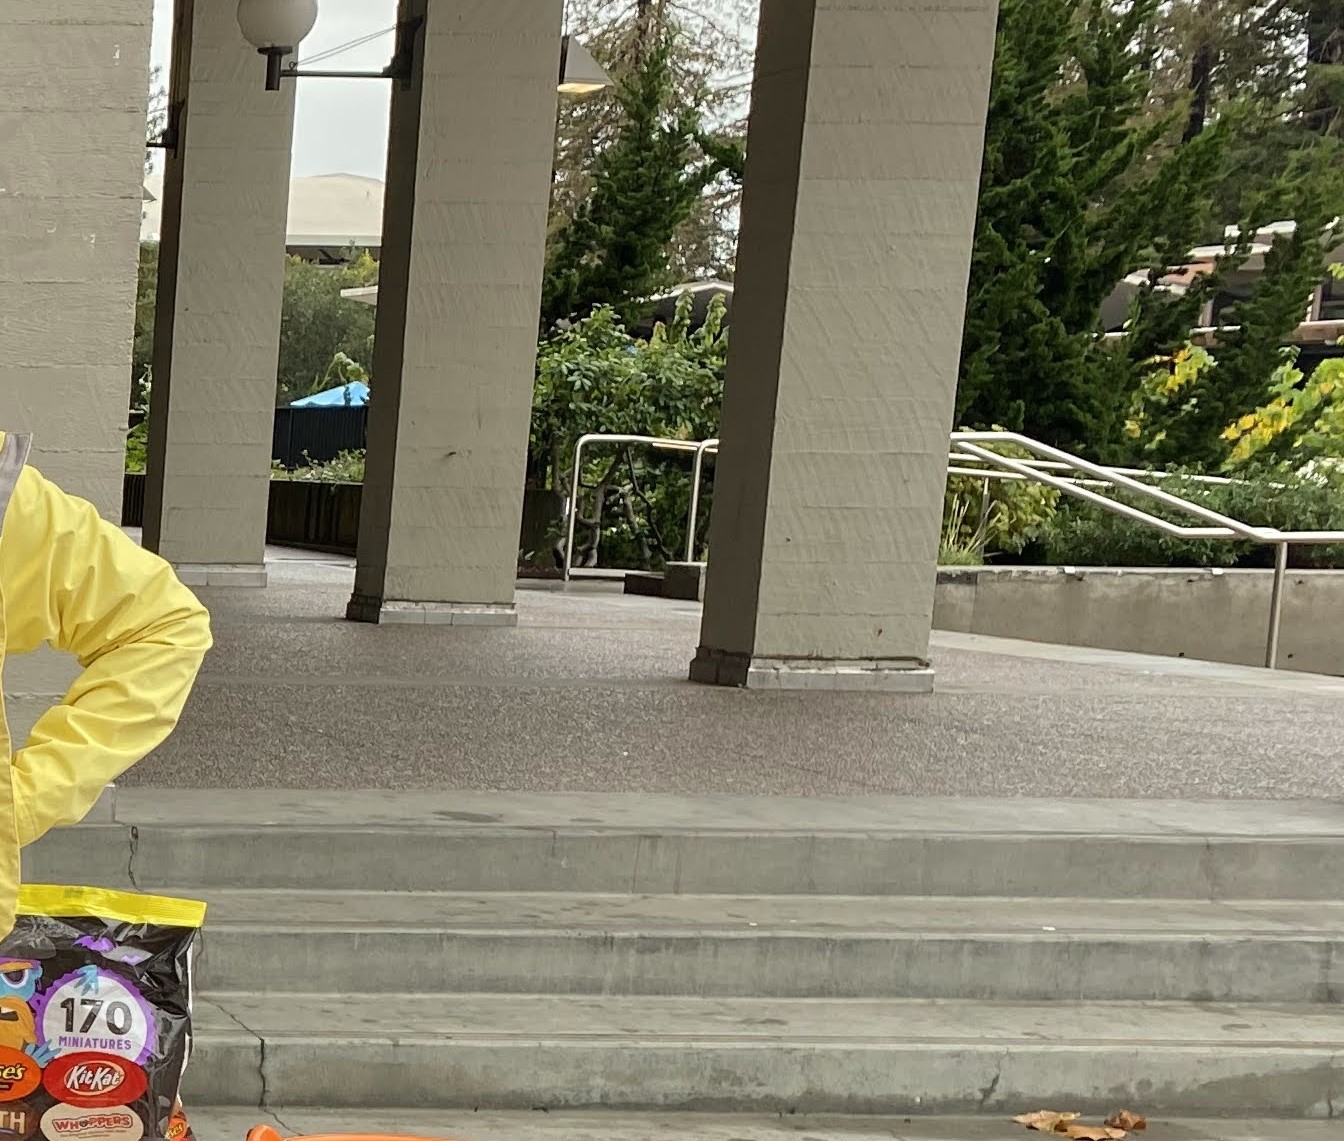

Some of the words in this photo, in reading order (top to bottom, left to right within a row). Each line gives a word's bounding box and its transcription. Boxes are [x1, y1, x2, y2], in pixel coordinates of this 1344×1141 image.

[60, 998, 132, 1035] 170
[58, 1036, 132, 1050] MINIATURES
[54, 1115, 131, 1133] WHOPPERS
